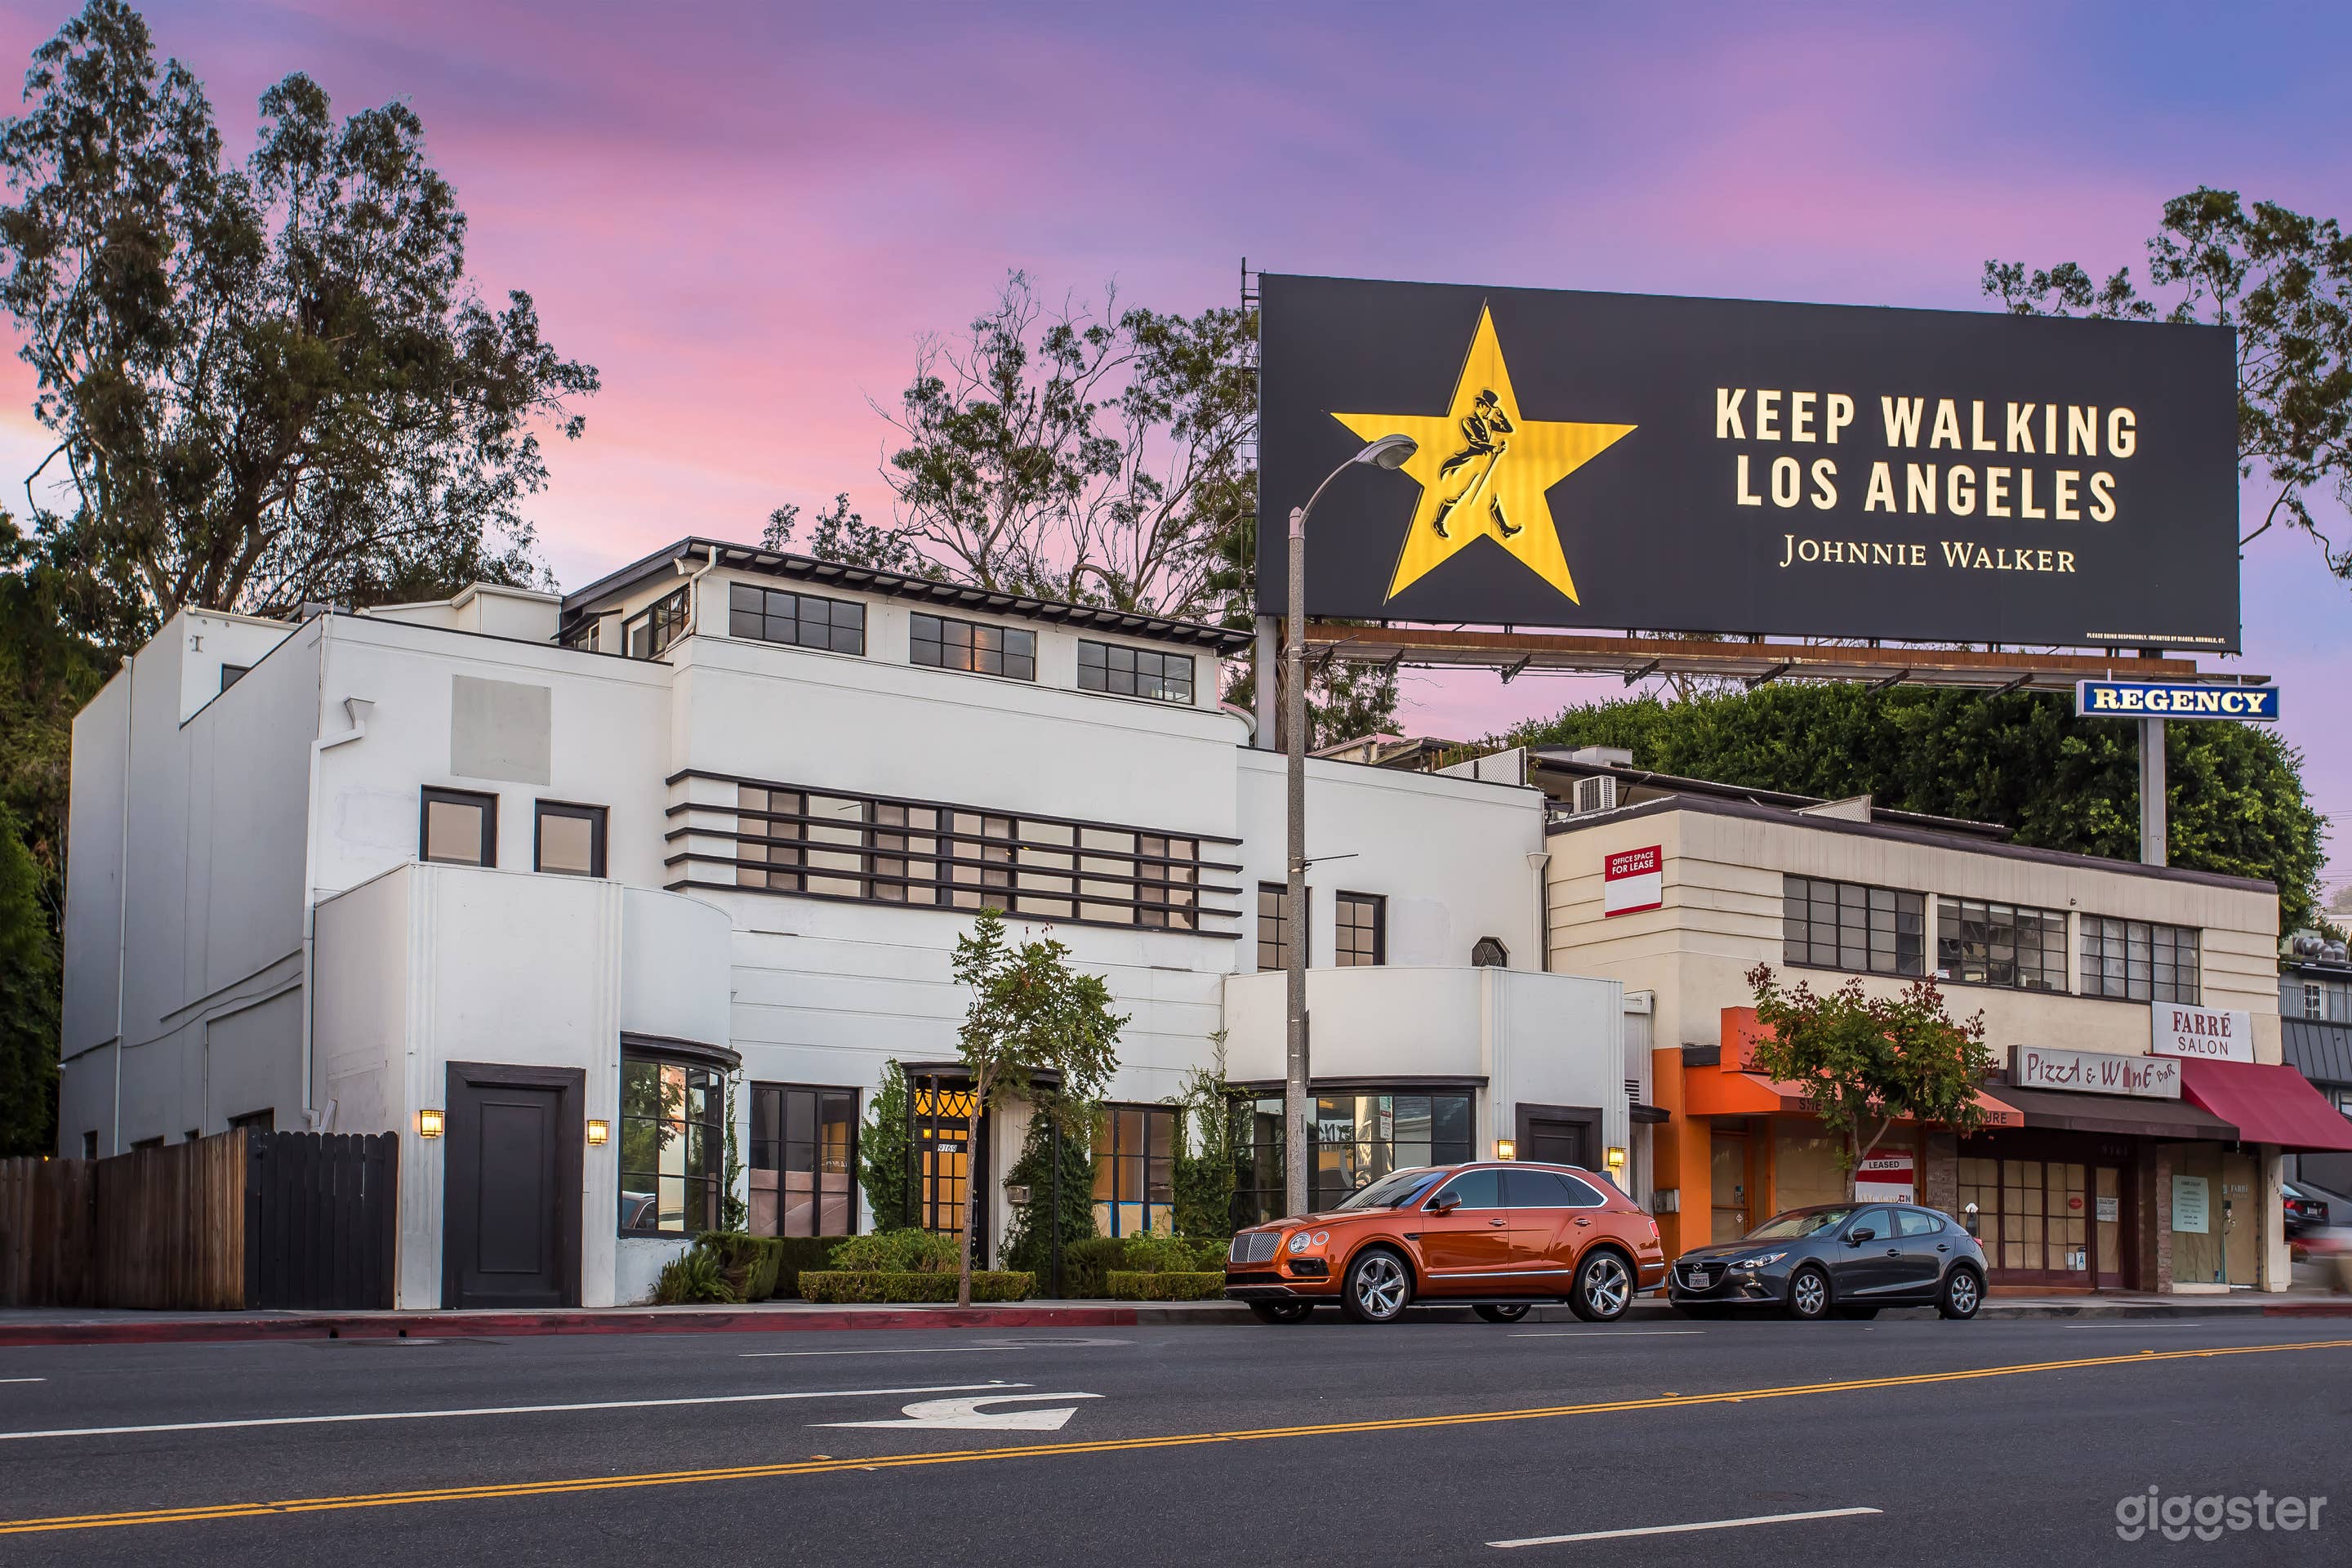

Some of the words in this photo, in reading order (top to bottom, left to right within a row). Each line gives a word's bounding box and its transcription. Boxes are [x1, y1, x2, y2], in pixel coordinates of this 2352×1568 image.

[1716, 387, 1855, 444] KEEP
[1880, 395, 2137, 459] WALKING
[1736, 454, 1838, 510] LOS
[1864, 461, 2118, 523] ANGELES
[1779, 533, 1927, 568] JOHNNIE
[1940, 541, 2077, 573] WALKER
[2093, 688, 2267, 714] REGENCY
[1612, 855, 1633, 866] OFFICE
[1633, 851, 1654, 862] SPACE
[1612, 864, 1628, 875] FOR
[1629, 859, 1654, 871] LEASE
[2172, 1011, 2232, 1038] FARRÉ
[2177, 1036, 2229, 1056] SALON
[2086, 1067, 2096, 1083] &
[1869, 1160, 1900, 1169] LEASED
